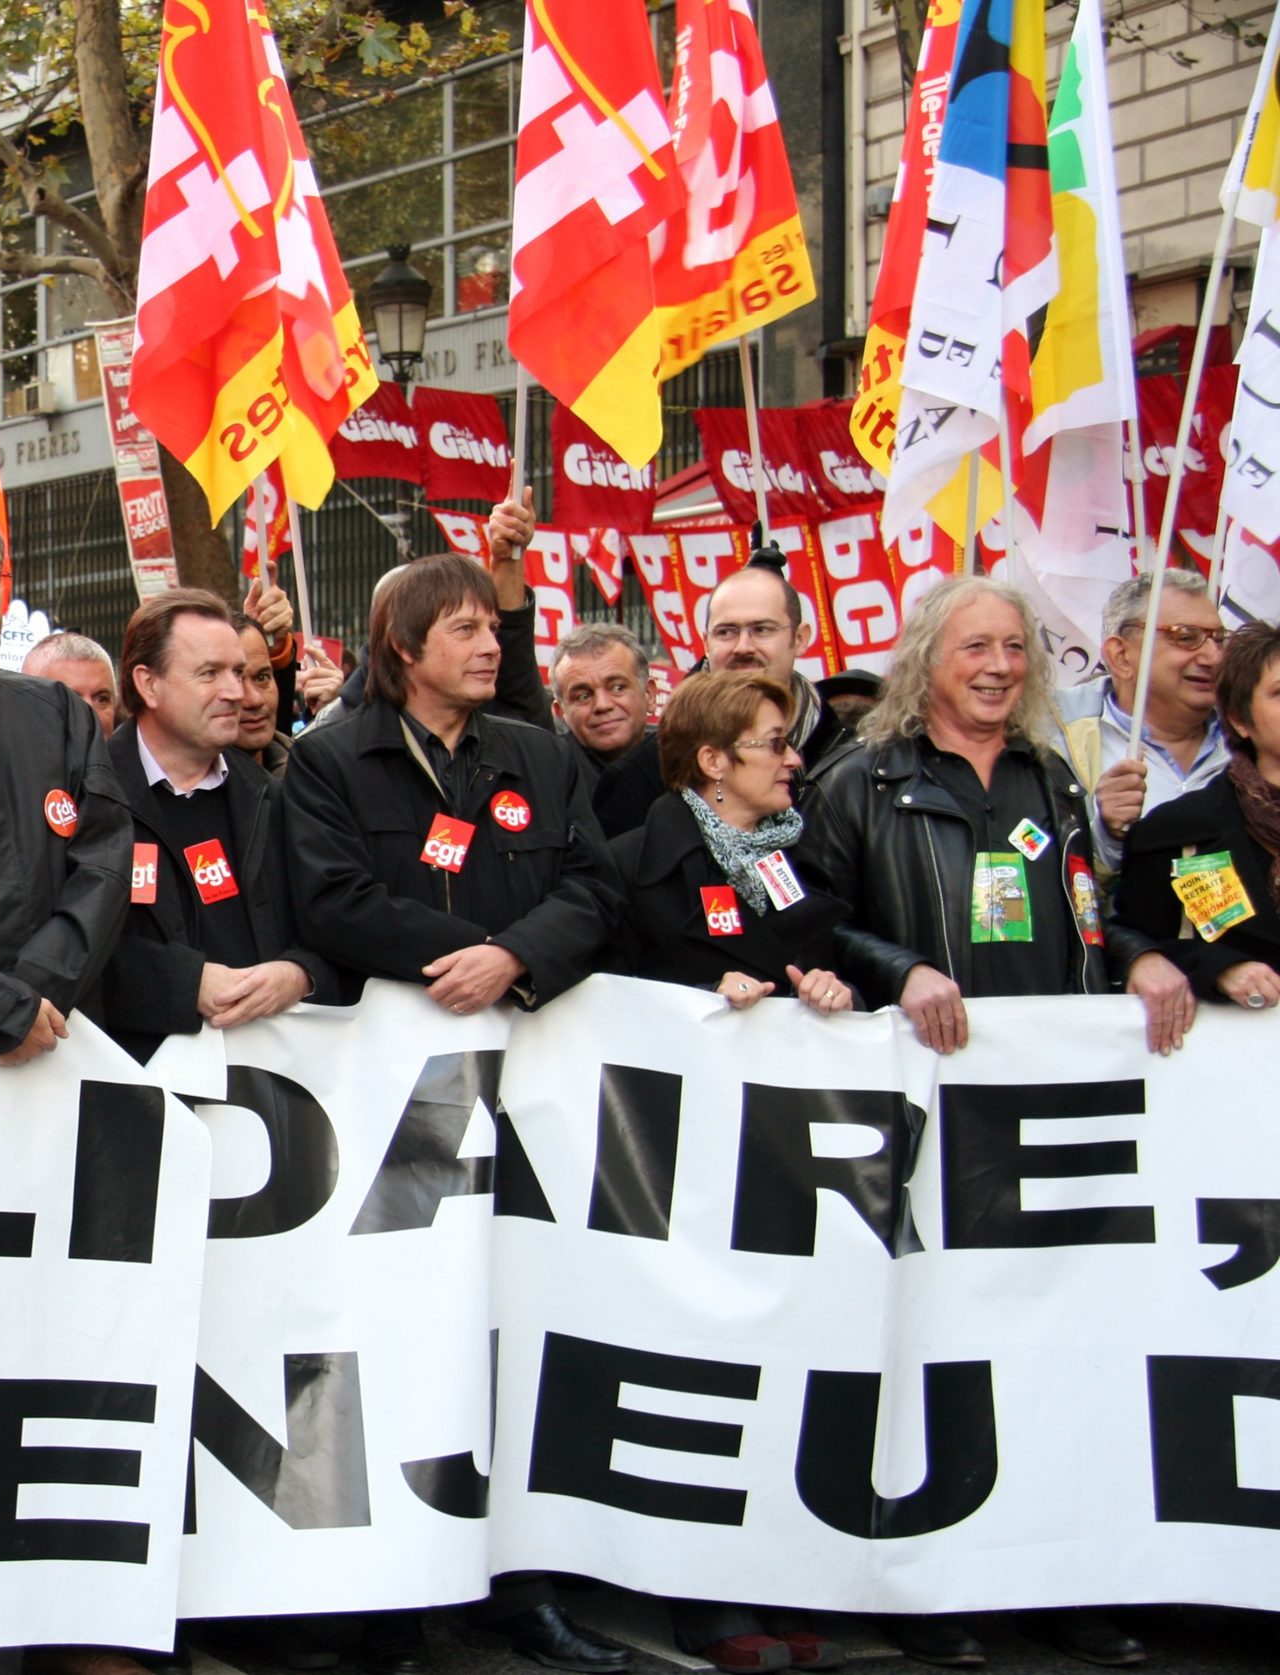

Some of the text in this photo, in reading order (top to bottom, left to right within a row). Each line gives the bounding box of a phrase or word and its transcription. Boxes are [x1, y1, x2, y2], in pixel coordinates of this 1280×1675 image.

[2, 630, 34, 642] CFTC
[494, 805, 528, 826] cgt
[424, 839, 467, 866] cgt
[194, 858, 232, 886] cgt
[1179, 872, 1207, 891] MOINS
[1184, 876, 1226, 901] RETRAITE
[708, 907, 741, 933] cgt
